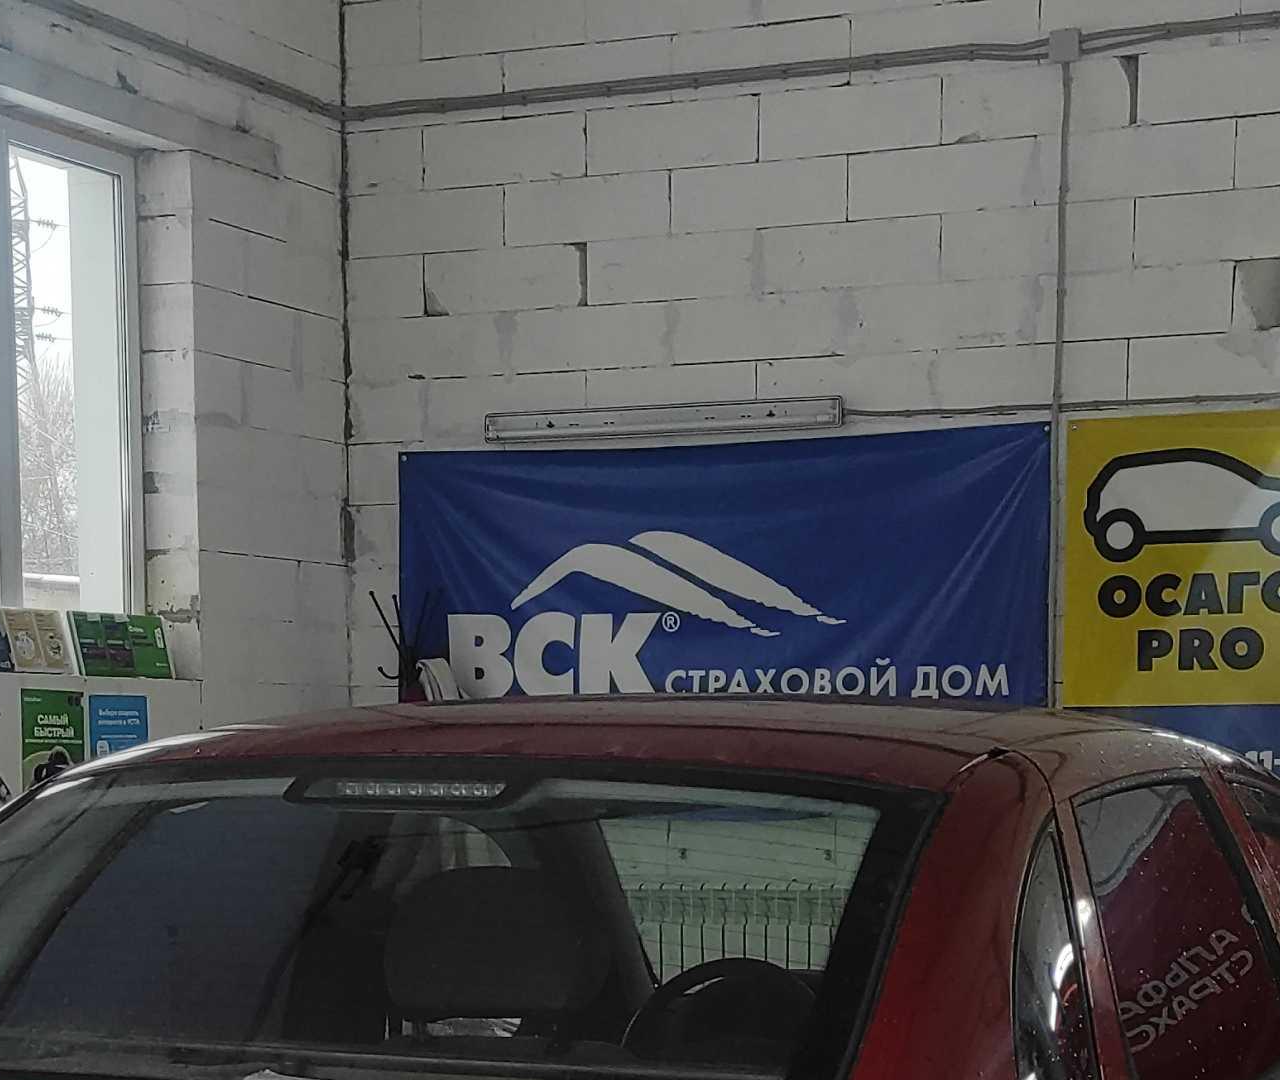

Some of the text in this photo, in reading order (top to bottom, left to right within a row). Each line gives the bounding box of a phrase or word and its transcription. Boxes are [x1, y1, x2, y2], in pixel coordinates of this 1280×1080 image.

[1137, 627, 1264, 672] PRO
[666, 658, 1008, 699] СТРАХОВОЙ ДОМ
